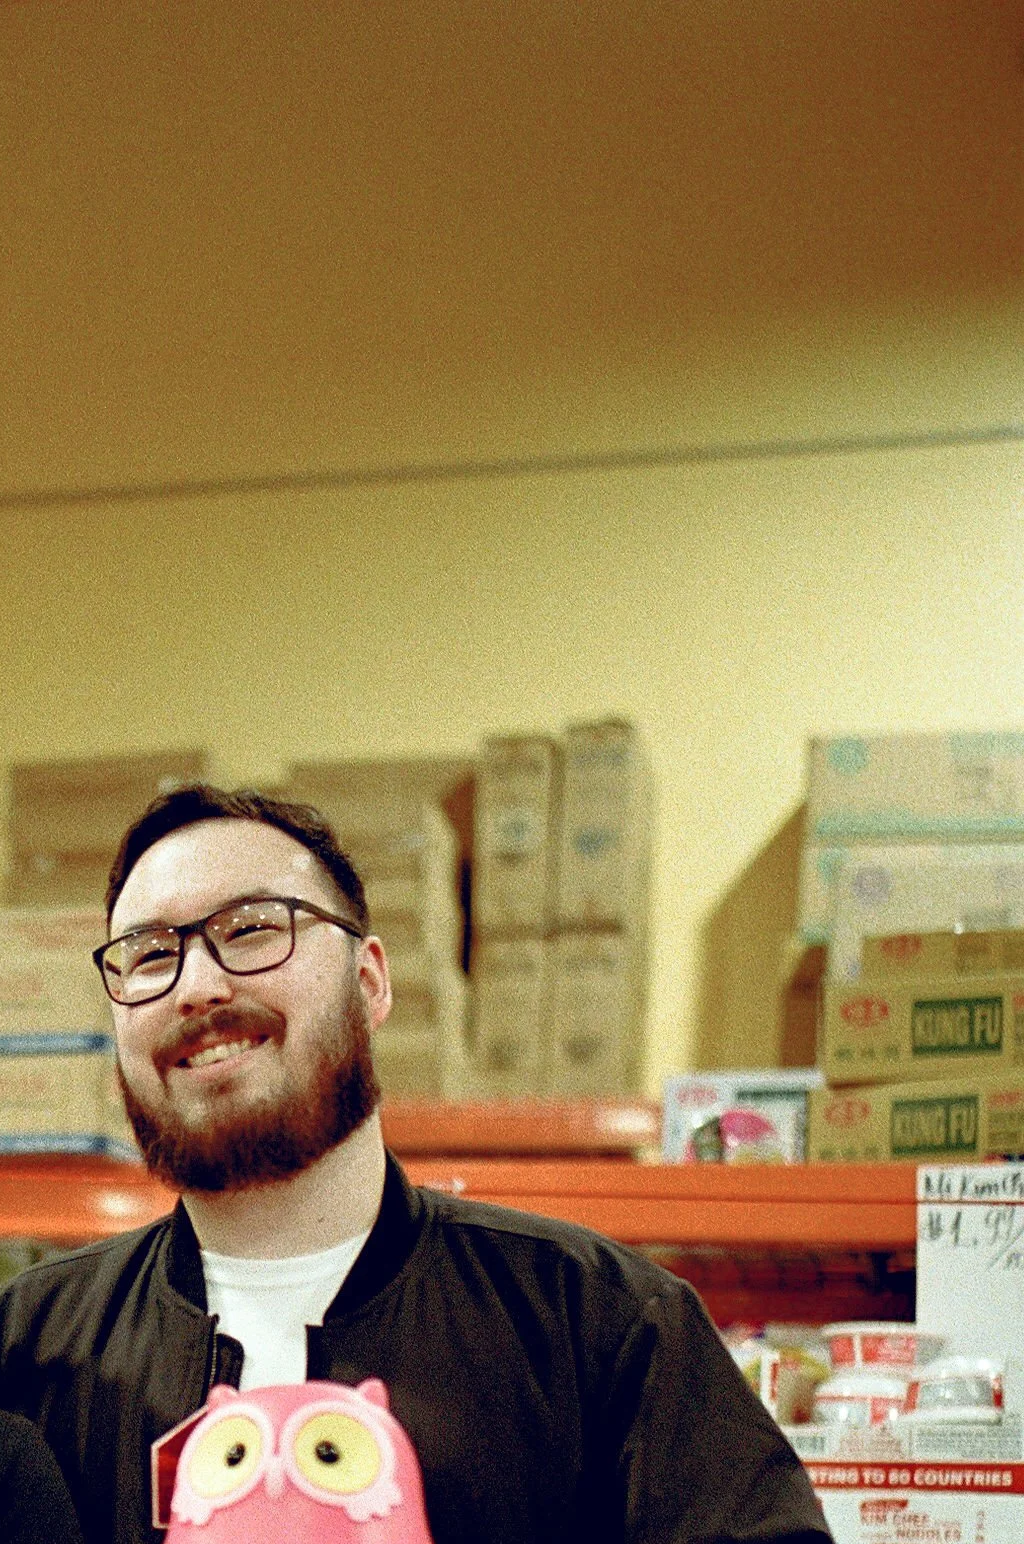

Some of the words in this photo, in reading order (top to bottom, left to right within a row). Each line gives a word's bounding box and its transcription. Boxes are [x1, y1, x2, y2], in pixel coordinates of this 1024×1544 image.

[914, 1005, 969, 1045] KUNG
[976, 1005, 1001, 1044] FU
[893, 1105, 945, 1145] KUNG
[949, 1104, 975, 1143] FU
[861, 1469, 886, 1485] TO
[888, 1469, 911, 1485] 80
[914, 1468, 1013, 1487] COUNTRIES
